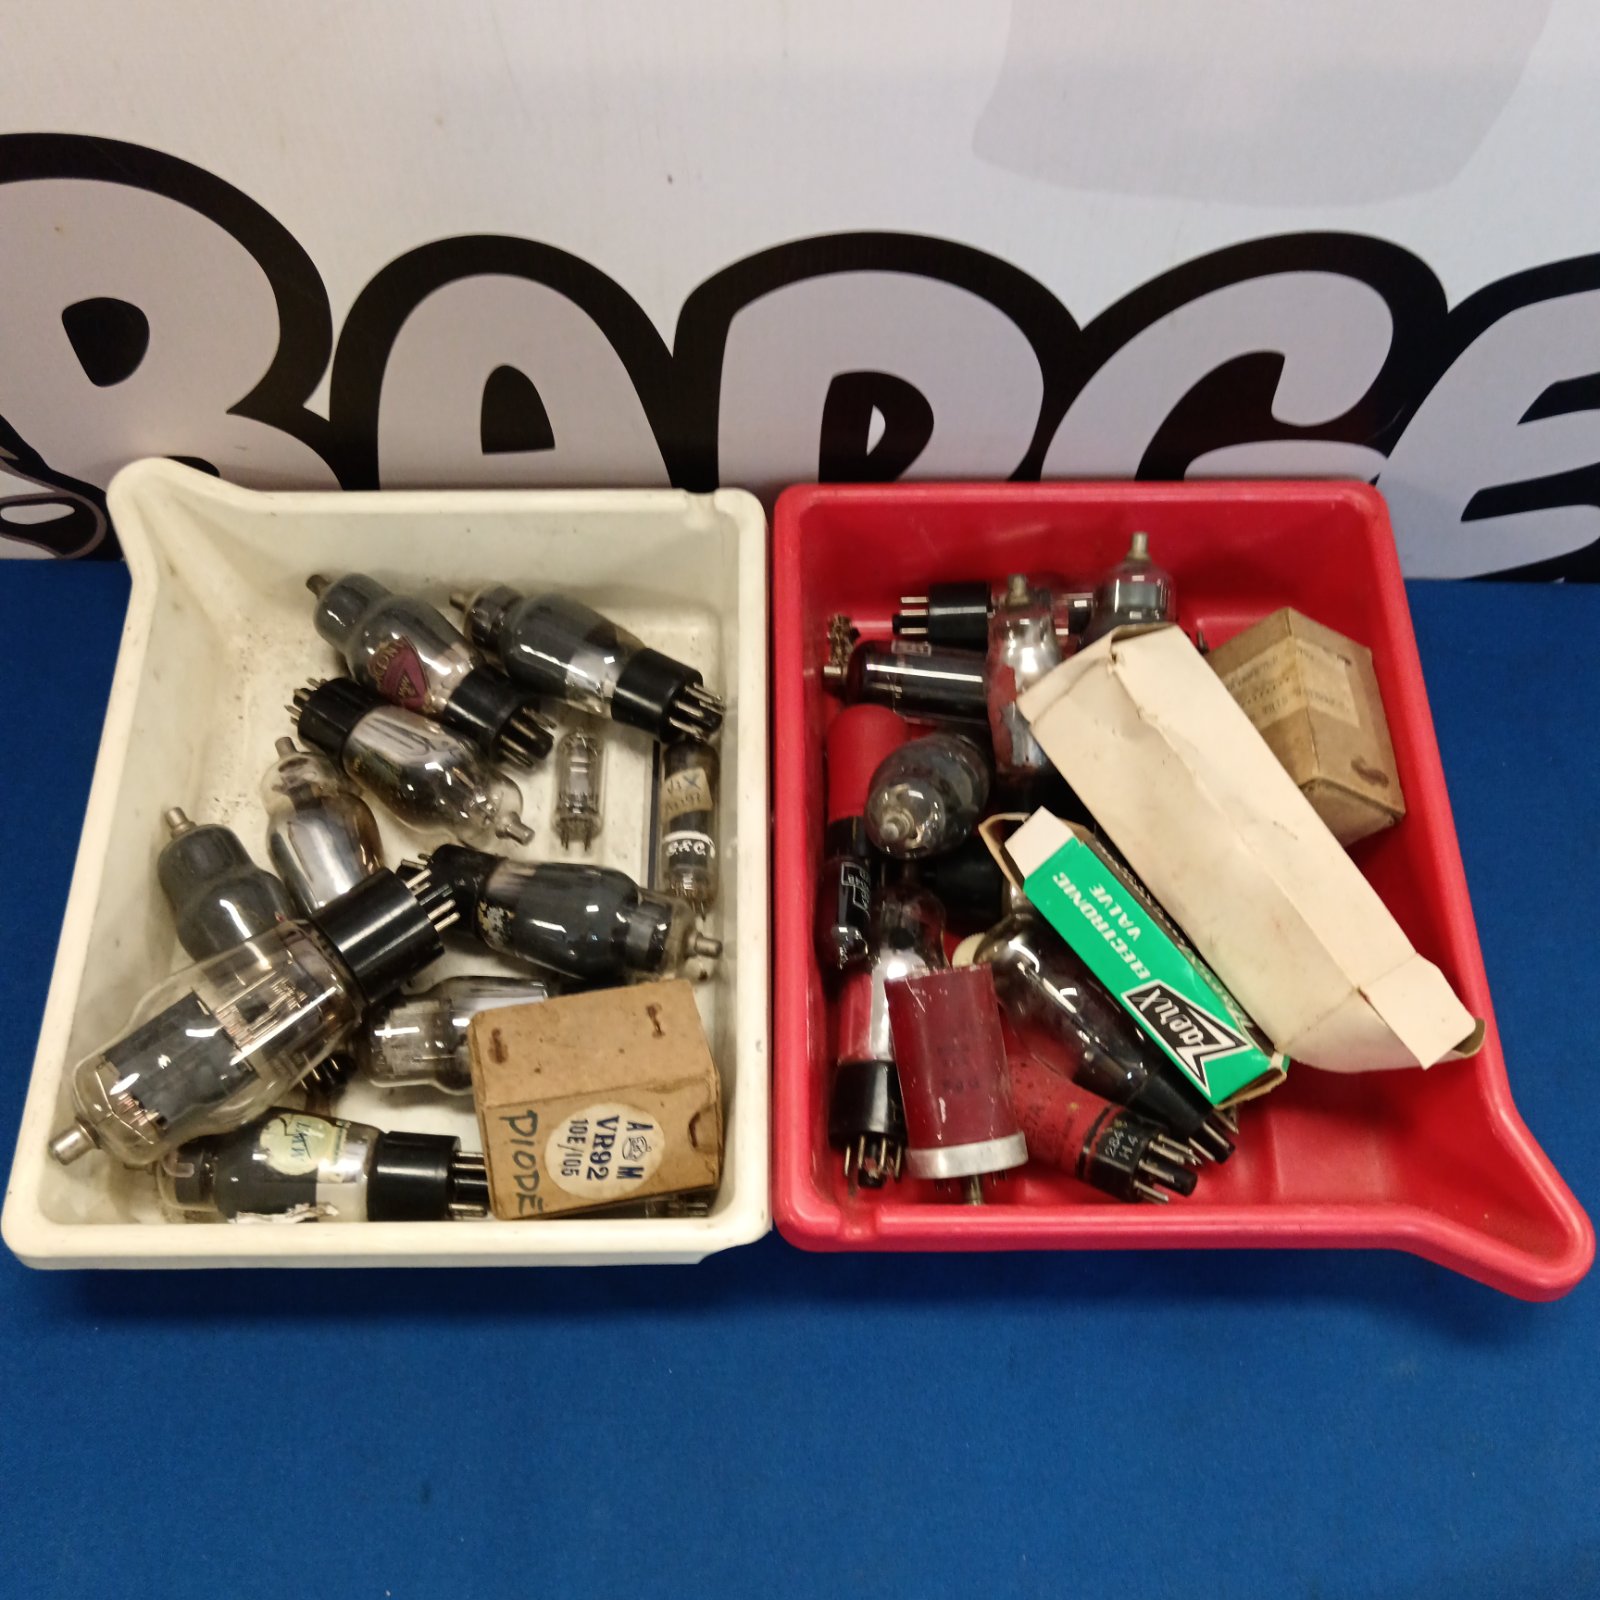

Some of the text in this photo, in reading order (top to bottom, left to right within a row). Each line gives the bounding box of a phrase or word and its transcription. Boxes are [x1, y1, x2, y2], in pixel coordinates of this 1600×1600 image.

[1053, 872, 1150, 979] ELECTRONIC
[1089, 883, 1141, 942] VALVE
[557, 1119, 590, 1177] 10E/105
[587, 1115, 620, 1181] VR92
[626, 1121, 654, 1131] A
